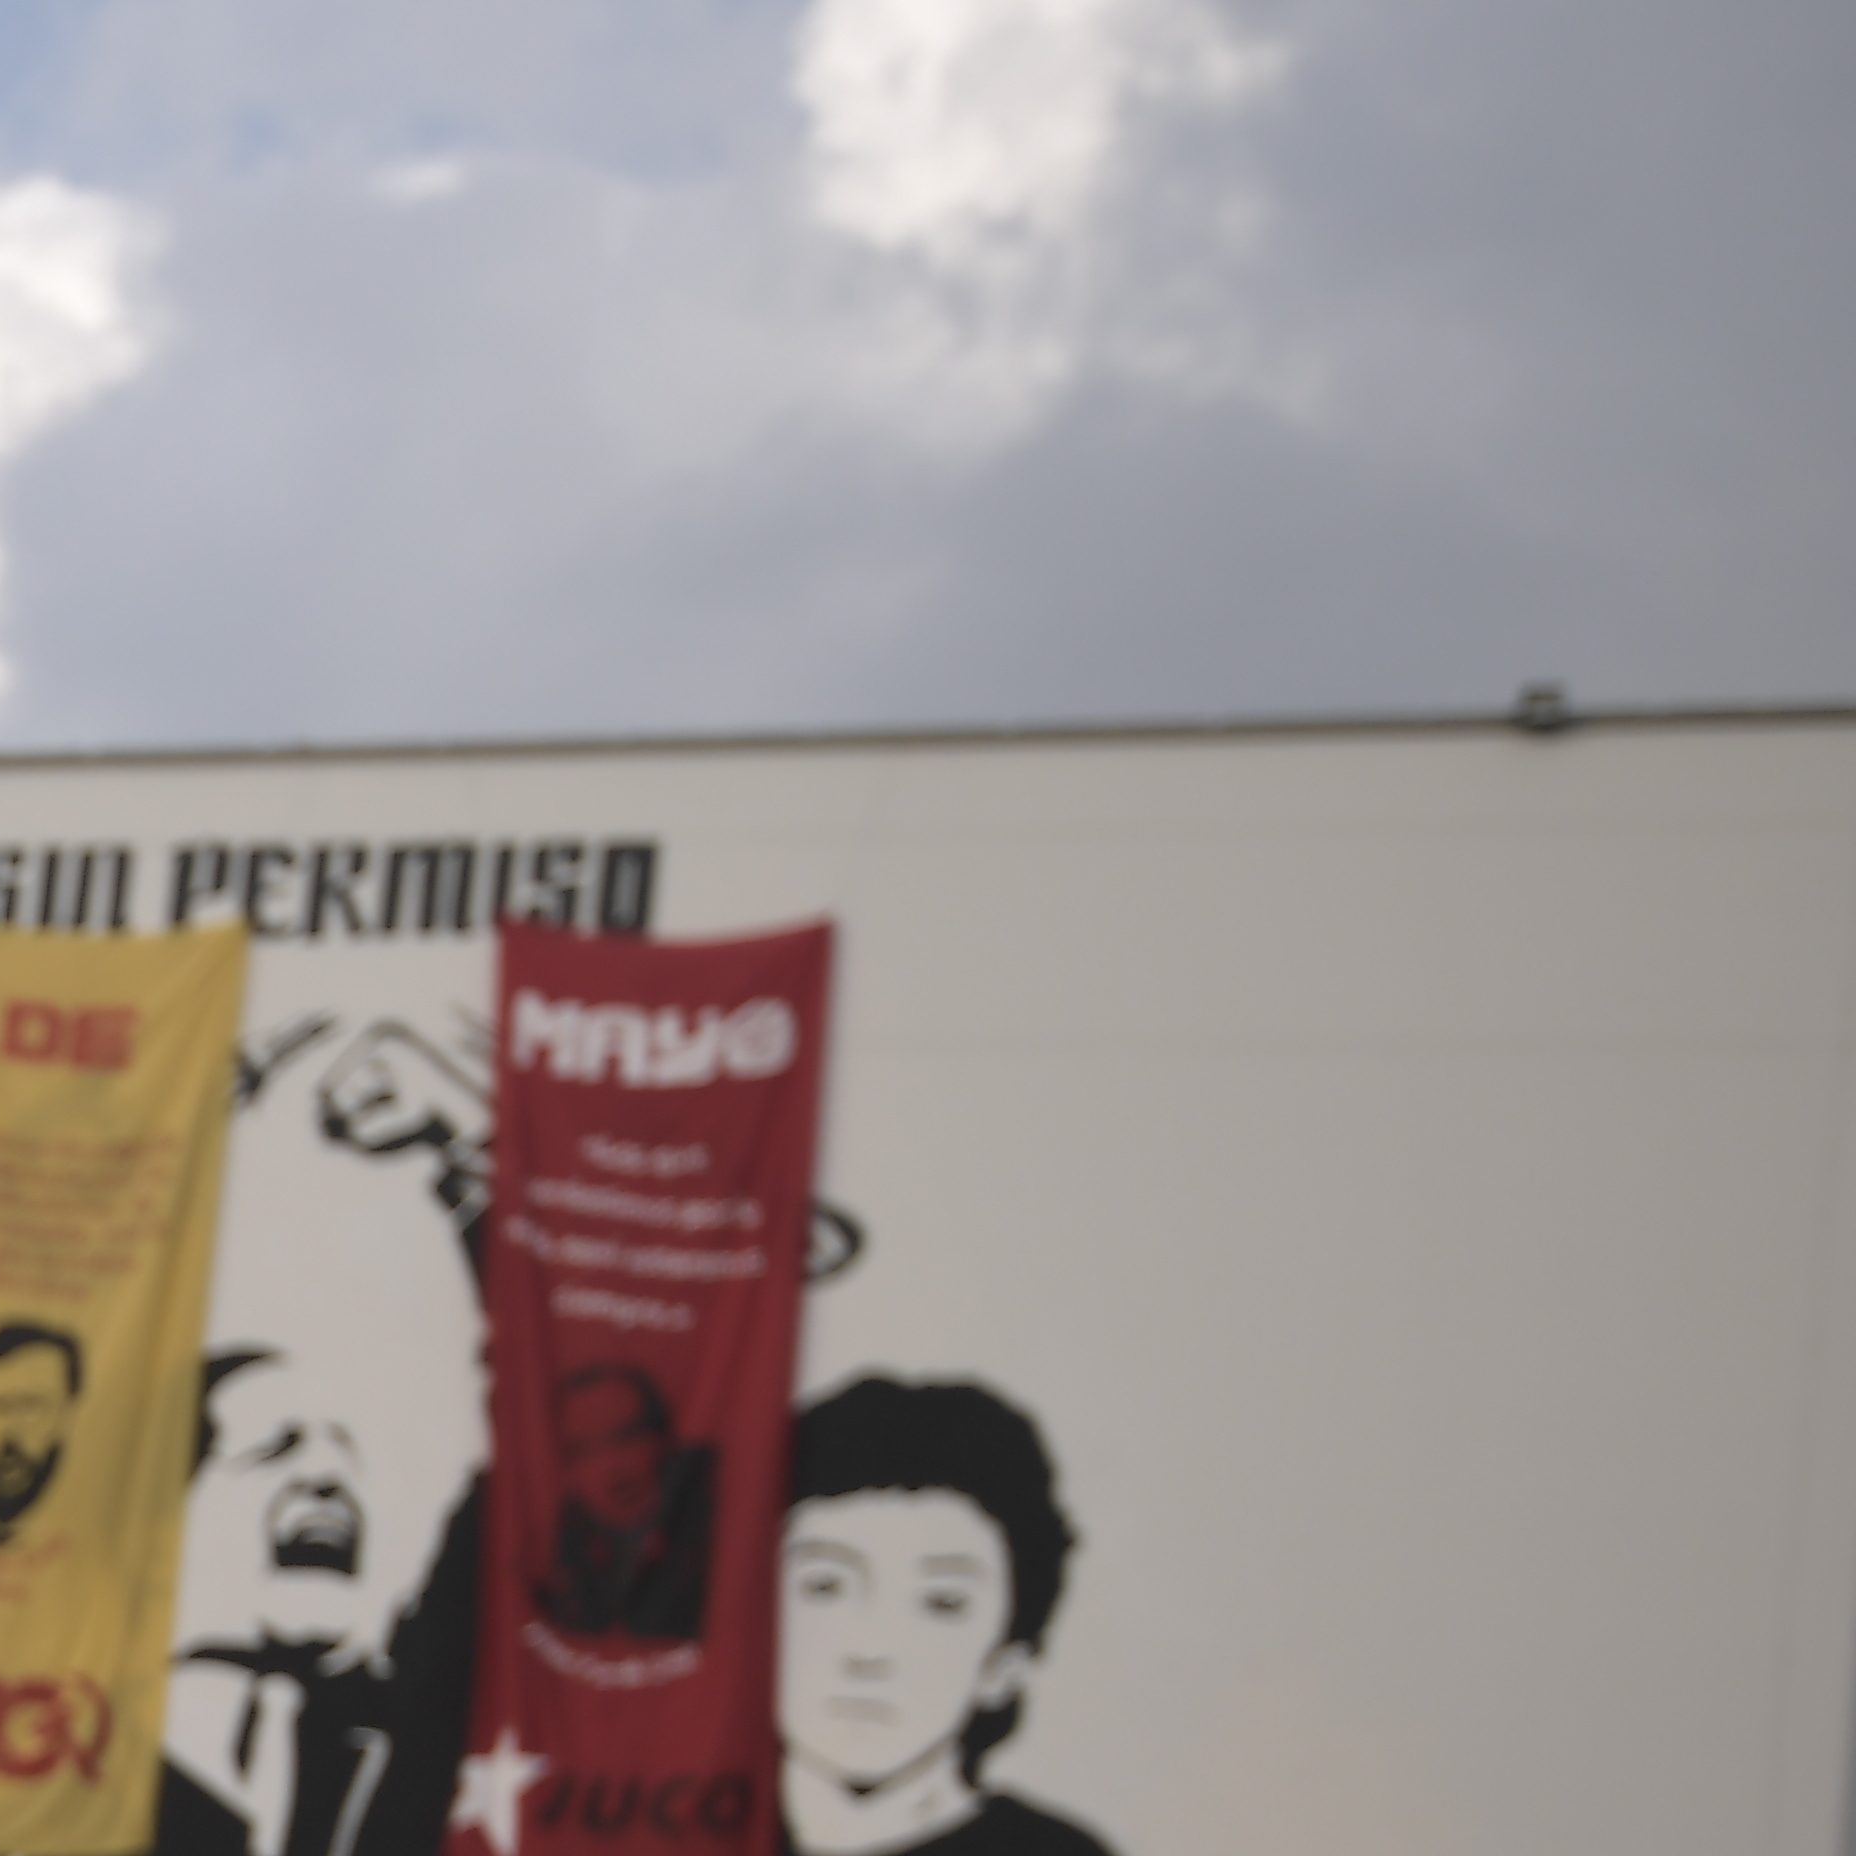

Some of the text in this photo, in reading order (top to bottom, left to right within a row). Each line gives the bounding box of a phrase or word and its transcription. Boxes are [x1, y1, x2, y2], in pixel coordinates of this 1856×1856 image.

[168, 841, 657, 938] PERMISO
[1, 997, 141, 1072] DE
[510, 989, 796, 1090] MAYO
[534, 1771, 758, 1842] JUCO
